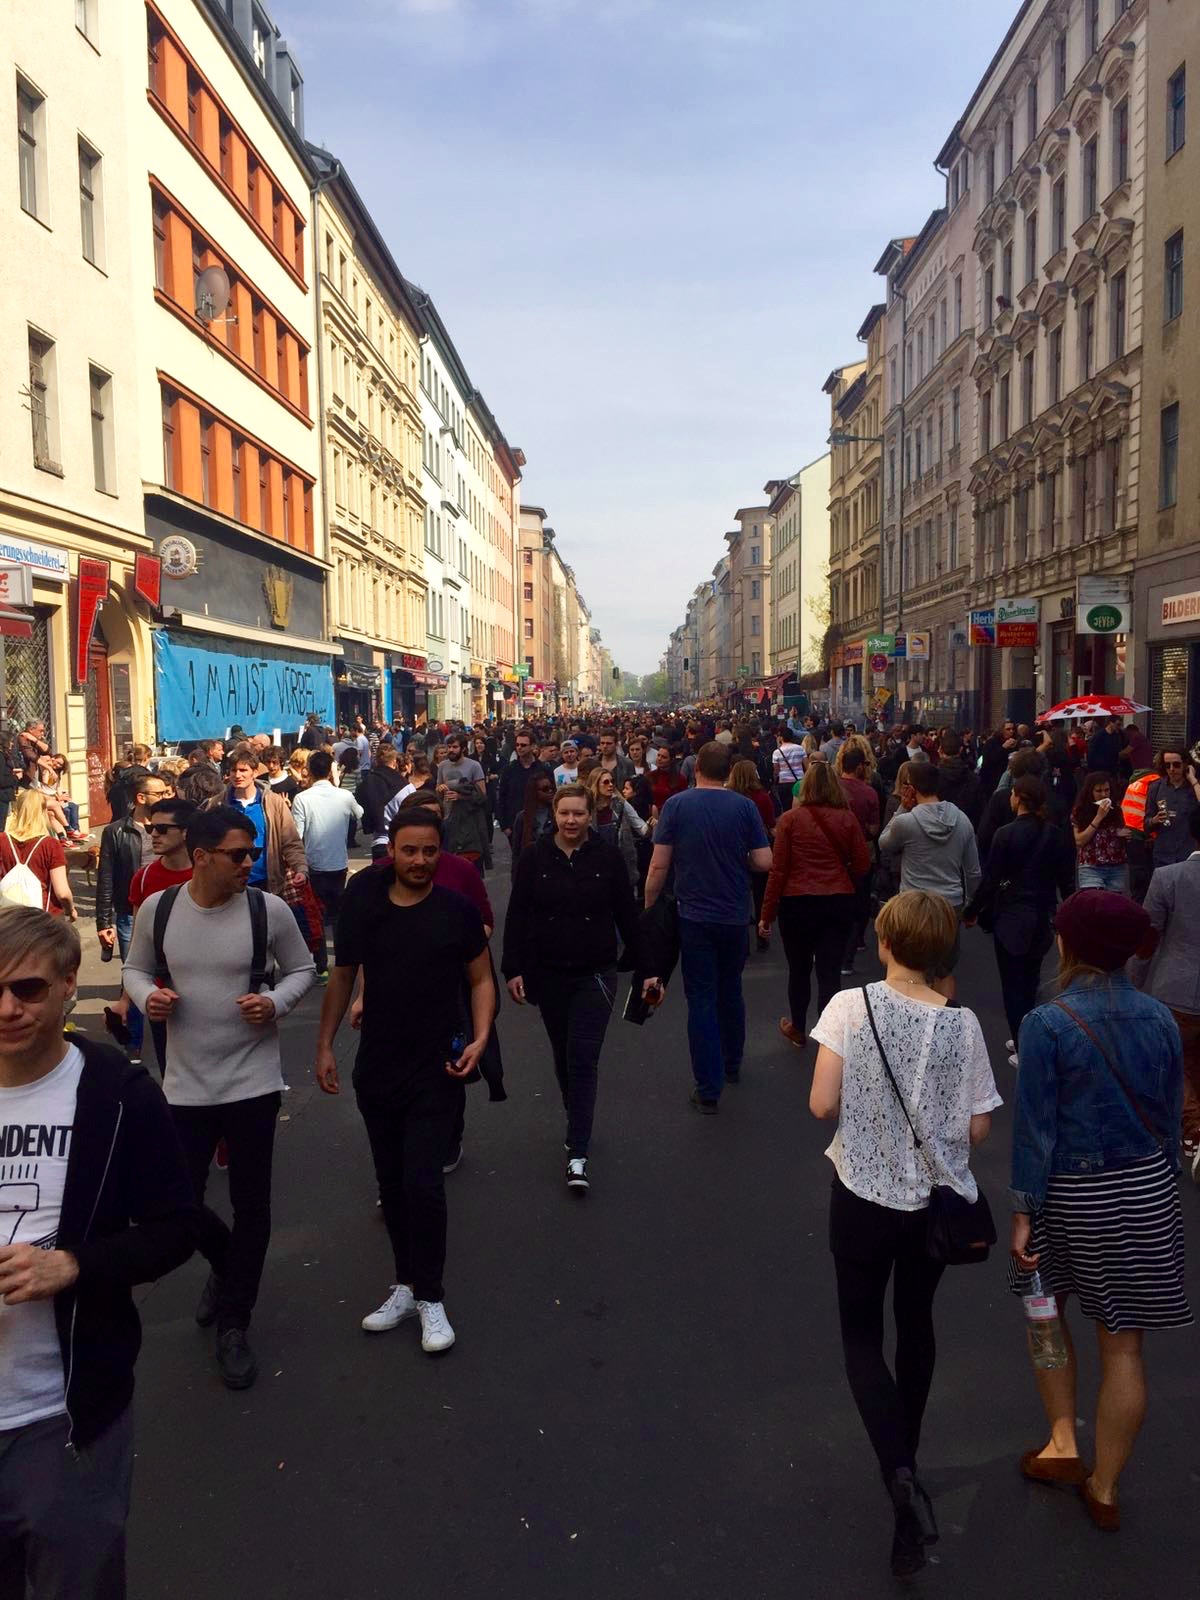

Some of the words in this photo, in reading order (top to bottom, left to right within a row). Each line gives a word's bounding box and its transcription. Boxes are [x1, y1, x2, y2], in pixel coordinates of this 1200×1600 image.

[1162, 595, 1200, 620] BILDER
[1093, 615, 1116, 628] JEVER
[188, 660, 201, 717] 1.
[205, 663, 240, 718] MAI
[245, 663, 268, 716] IST
